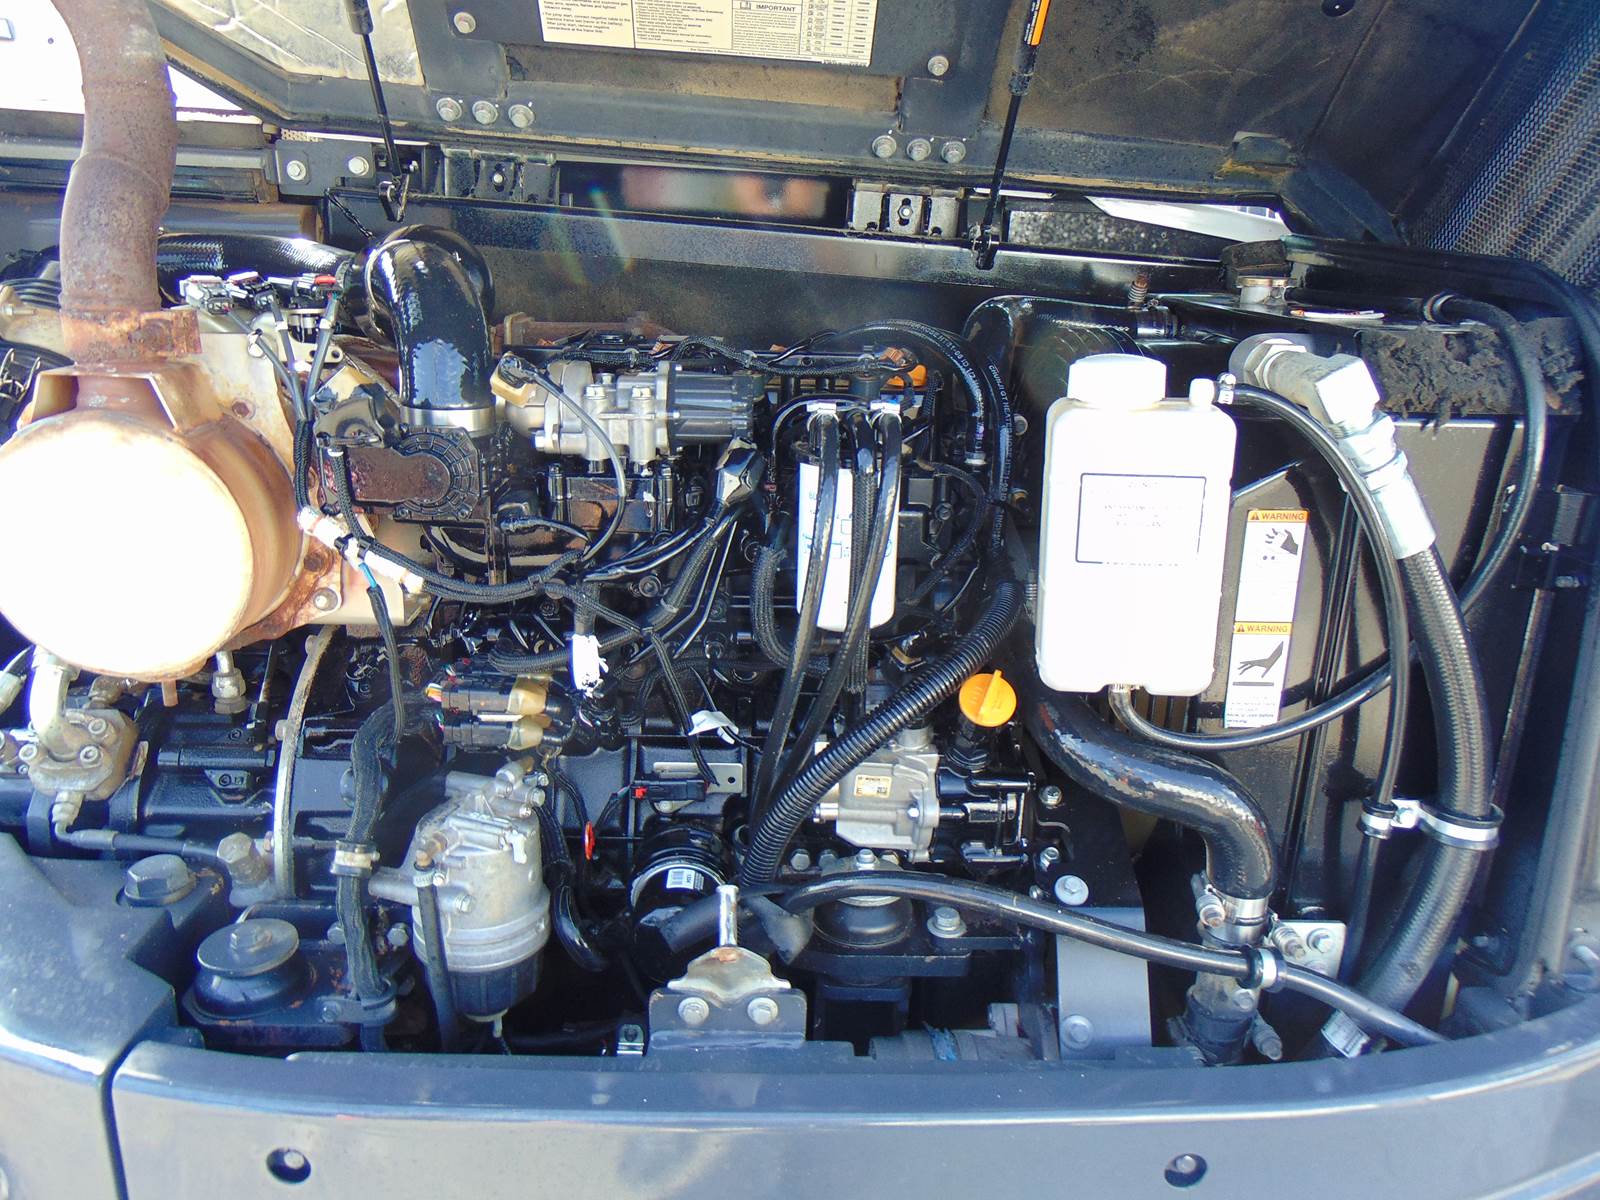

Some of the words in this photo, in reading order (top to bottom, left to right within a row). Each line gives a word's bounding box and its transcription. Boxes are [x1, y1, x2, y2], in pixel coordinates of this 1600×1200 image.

[756, 4, 796, 12] IMPORTANT
[1261, 512, 1305, 521] WARNING
[1246, 624, 1288, 633] WARNING
